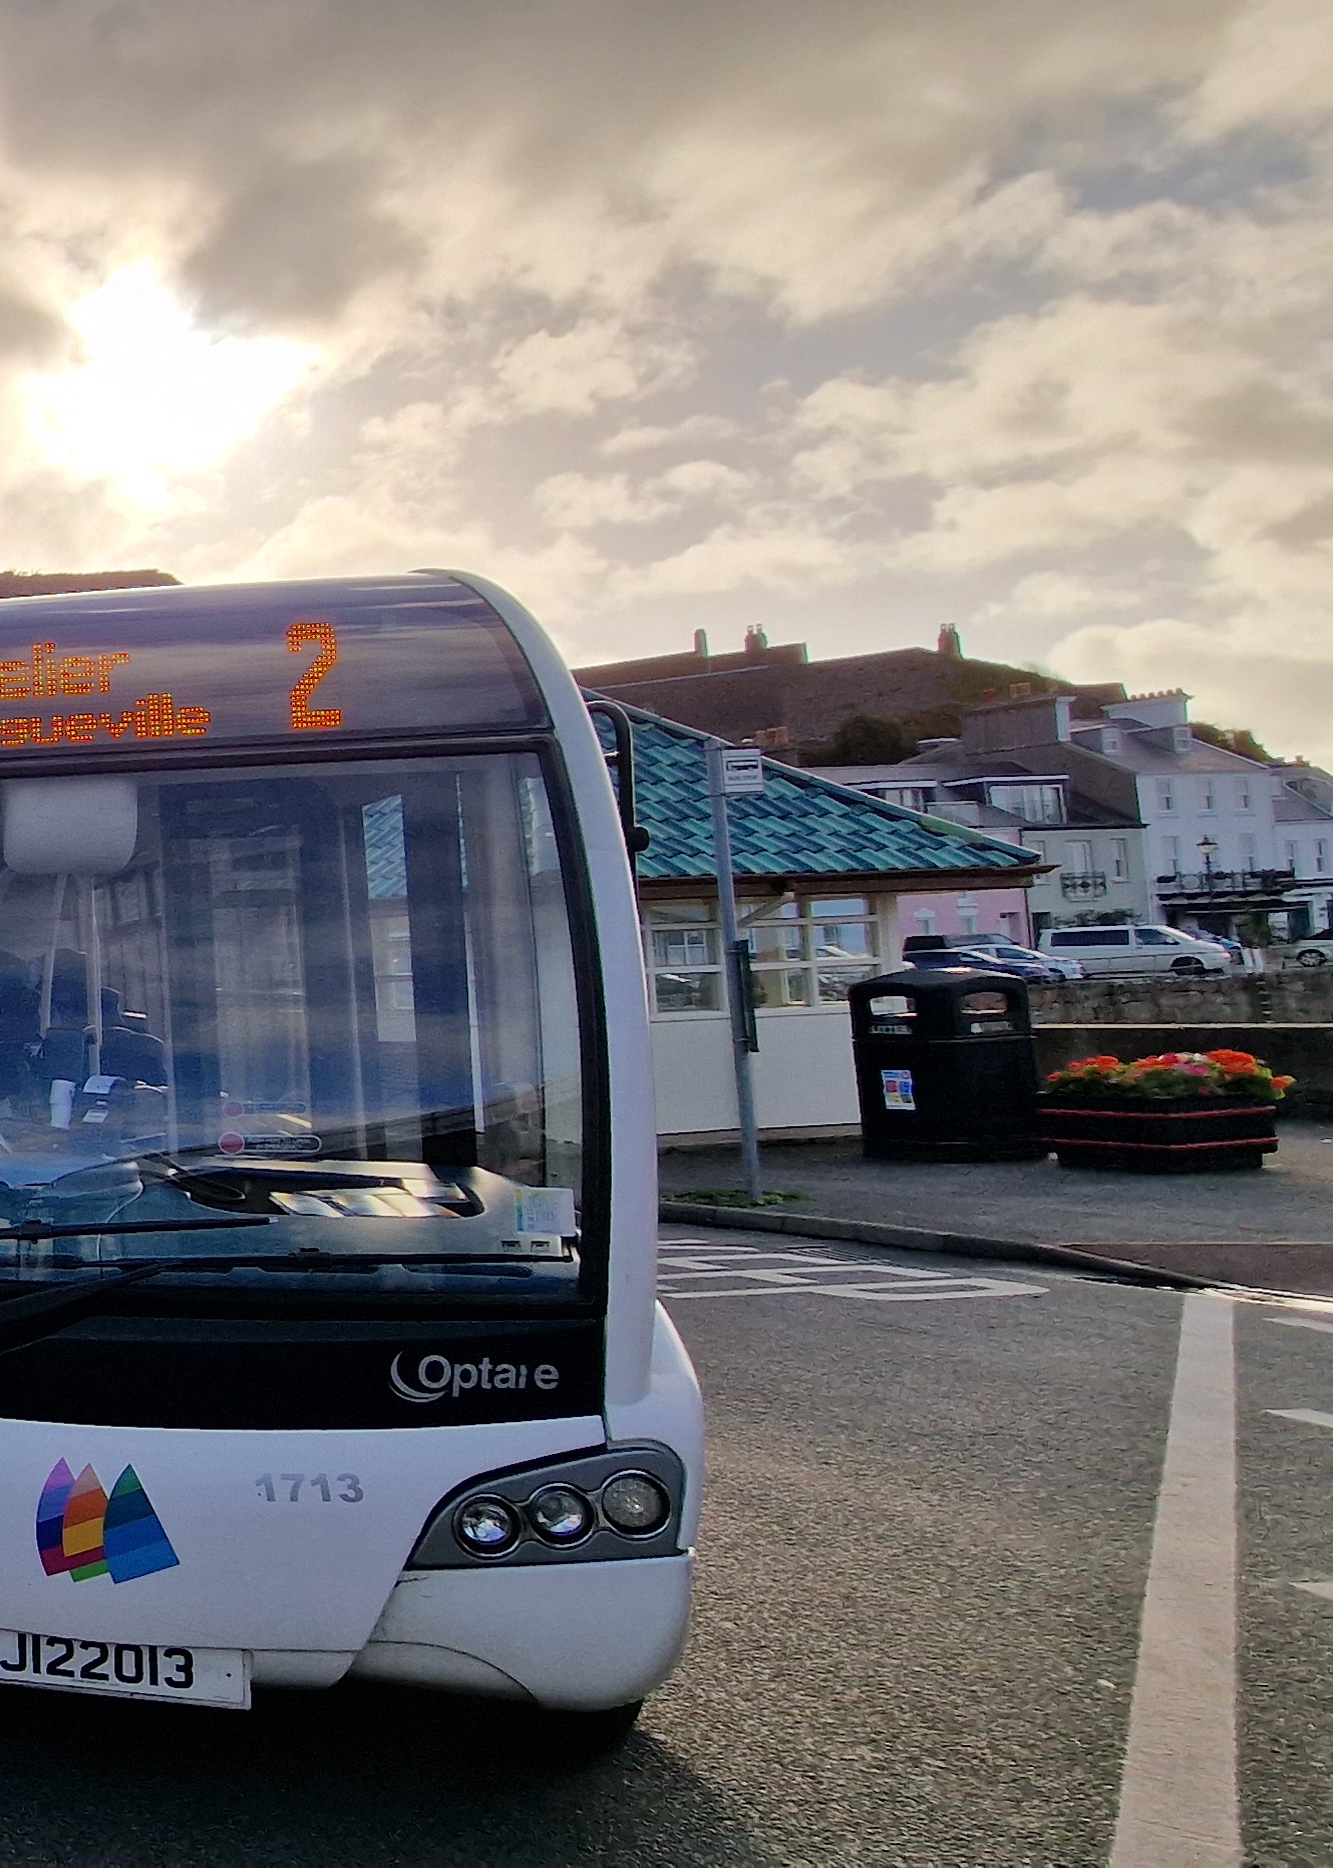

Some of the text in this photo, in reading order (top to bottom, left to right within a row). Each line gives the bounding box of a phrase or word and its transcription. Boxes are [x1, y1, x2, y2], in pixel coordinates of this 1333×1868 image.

[286, 621, 342, 730] 2
[254, 1472, 364, 1503] 1713
[0, 1632, 194, 1690] J122013
